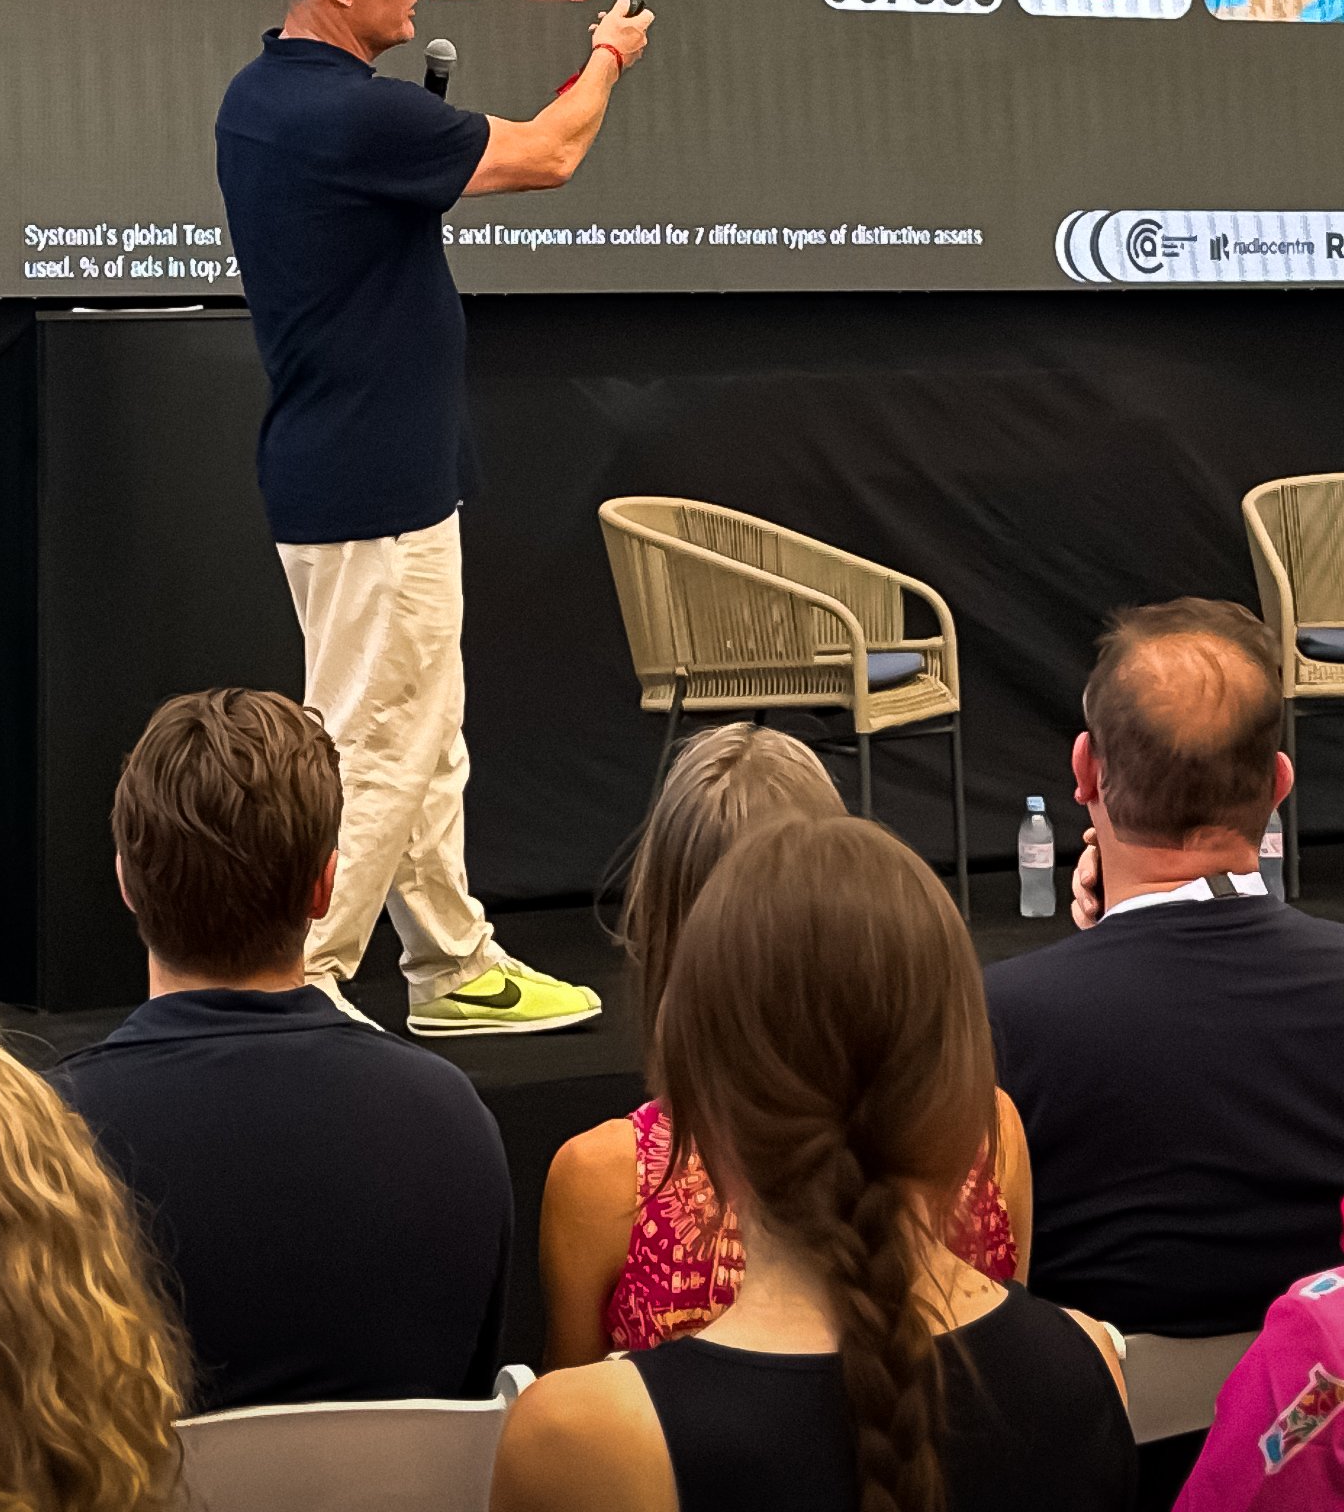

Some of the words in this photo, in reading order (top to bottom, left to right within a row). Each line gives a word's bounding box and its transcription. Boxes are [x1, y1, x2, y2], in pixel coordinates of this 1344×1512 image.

[122, 223, 178, 251] global
[183, 224, 223, 246] Test
[458, 223, 491, 245] and
[494, 224, 573, 251] European
[576, 223, 606, 245] ads
[610, 223, 662, 245] coded
[665, 223, 690, 245] for
[708, 223, 779, 245] different
[782, 226, 827, 250] types
[829, 223, 848, 245] of
[851, 223, 931, 245] distinctive
[933, 226, 984, 245] assets
[24, 255, 75, 278] used.
[79, 256, 100, 278] %
[104, 255, 126, 278] of
[130, 255, 164, 278] ads
[168, 256, 186, 278] in
[190, 257, 222, 283] top
[225, 256, 241, 278] 2
